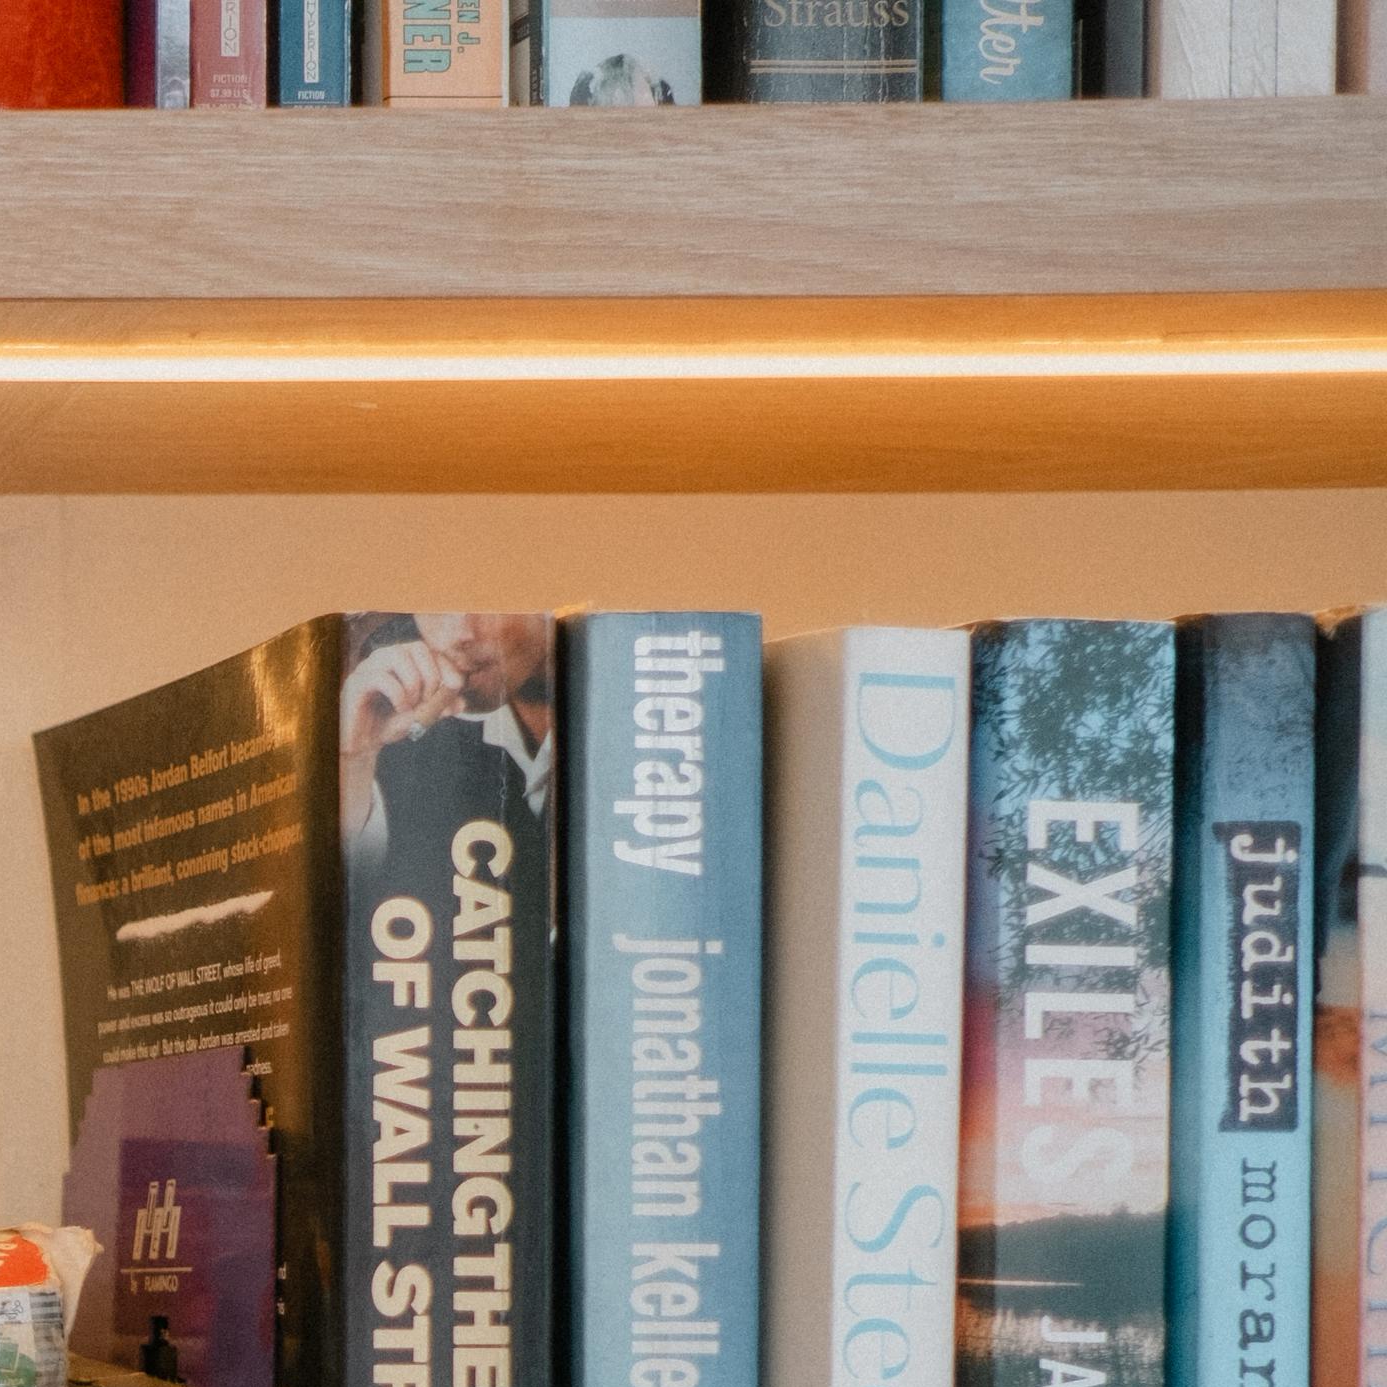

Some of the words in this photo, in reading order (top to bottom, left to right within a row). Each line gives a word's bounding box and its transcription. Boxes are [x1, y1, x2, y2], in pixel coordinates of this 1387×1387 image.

[763, 0, 910, 27] Strauss
[213, 74, 248, 84] FICTION
[298, 90, 325, 100] FICTION
[91, 787, 111, 811] the
[114, 775, 148, 804] 1990s
[151, 763, 188, 793] Jordan
[190, 746, 228, 779] Belfort
[613, 630, 725, 877] therapy
[79, 837, 91, 860] of
[92, 833, 111, 856] the
[114, 824, 142, 851] most
[144, 809, 195, 841] infamous
[197, 797, 233, 825] names
[236, 788, 247, 813] in
[250, 772, 297, 808] American
[176, 847, 229, 880] conniving
[371, 896, 433, 1009] OF
[848, 671, 957, 1151] Danielle
[131, 980, 144, 996] THE
[145, 974, 163, 993] WOLF
[166, 972, 176, 990] OF
[177, 968, 195, 988] WALL
[223, 960, 243, 978] whose
[245, 954, 254, 974] life
[256, 952, 264, 974] of
[152, 1011, 164, 1025] was
[165, 1010, 172, 1022] so
[174, 1003, 208, 1023] outrageous
[215, 993, 233, 1013] could
[234, 991, 248, 1013] only
[249, 991, 257, 1007] be
[1022, 800, 1141, 1184] EXILES
[1230, 832, 1297, 1122] judith
[162, 1038, 173, 1055] But
[174, 1035, 185, 1053] the
[186, 1034, 198, 1052] day
[198, 1031, 221, 1050] Jordan
[221, 1032, 233, 1046] was
[235, 1024, 260, 1044] arrested
[261, 1022, 273, 1040] and
[451, 818, 514, 1237] CATCHING
[612, 933, 724, 1218] jonathan
[372, 1024, 431, 1248] WALL
